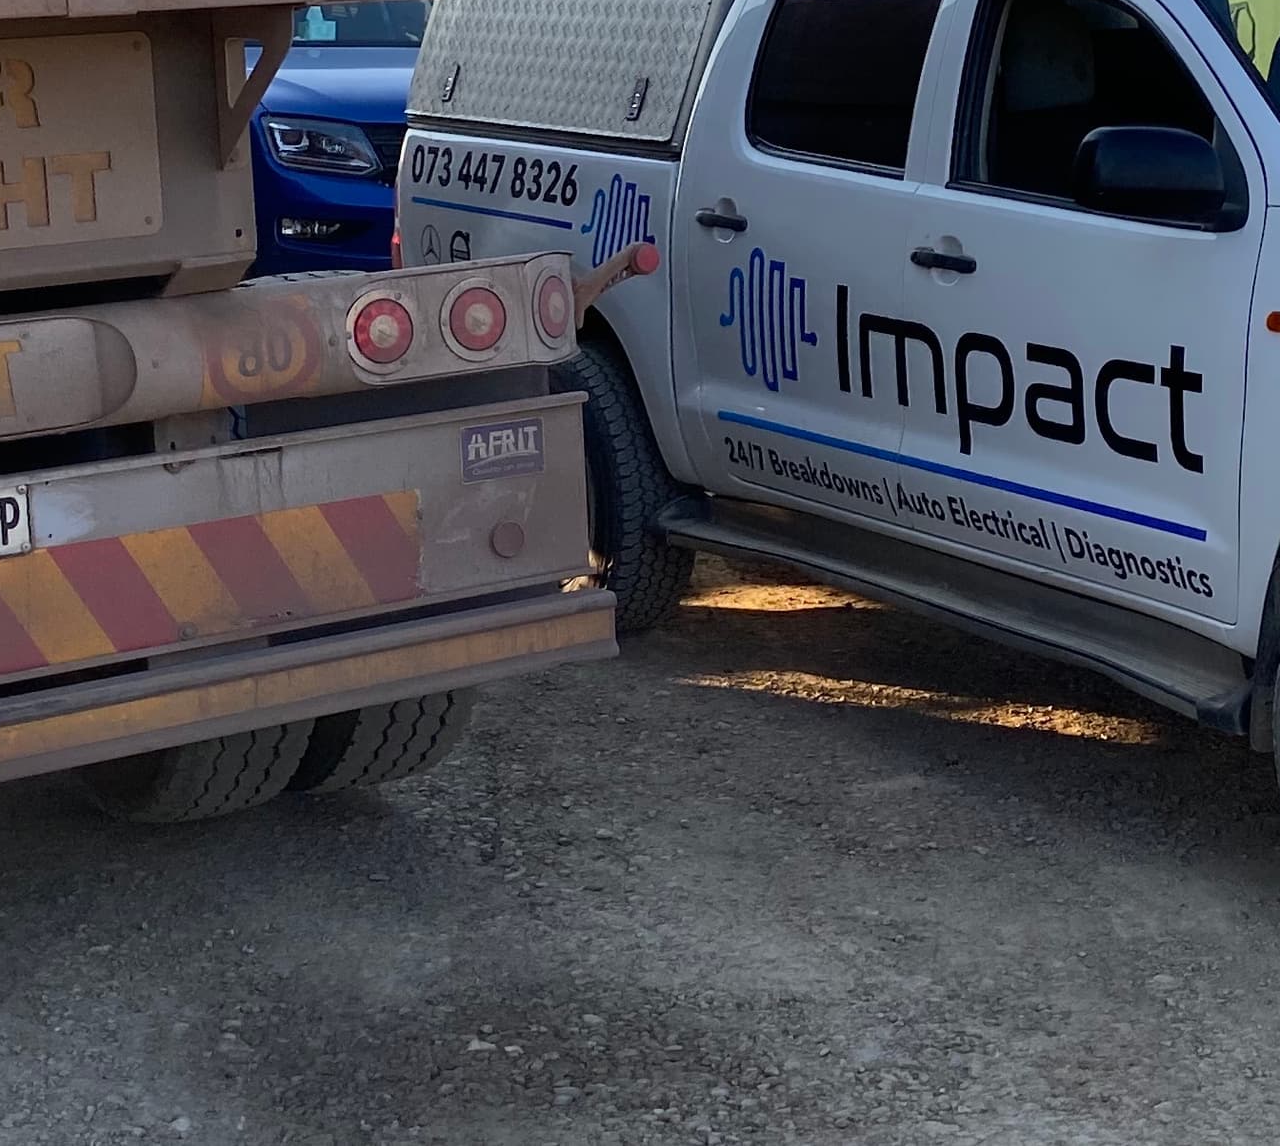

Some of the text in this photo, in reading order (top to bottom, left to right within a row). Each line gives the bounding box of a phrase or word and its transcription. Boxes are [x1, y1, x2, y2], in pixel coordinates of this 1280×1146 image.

[411, 145, 578, 206] 073 447 8326
[836, 283, 1204, 474] Impact
[467, 425, 538, 462] AFRIT
[724, 436, 764, 471] 24/7
[769, 449, 884, 505] Breakdowns
[896, 483, 946, 521] Auto
[947, 495, 1051, 550] Electrical
[1064, 527, 1214, 598] Diagnostics
